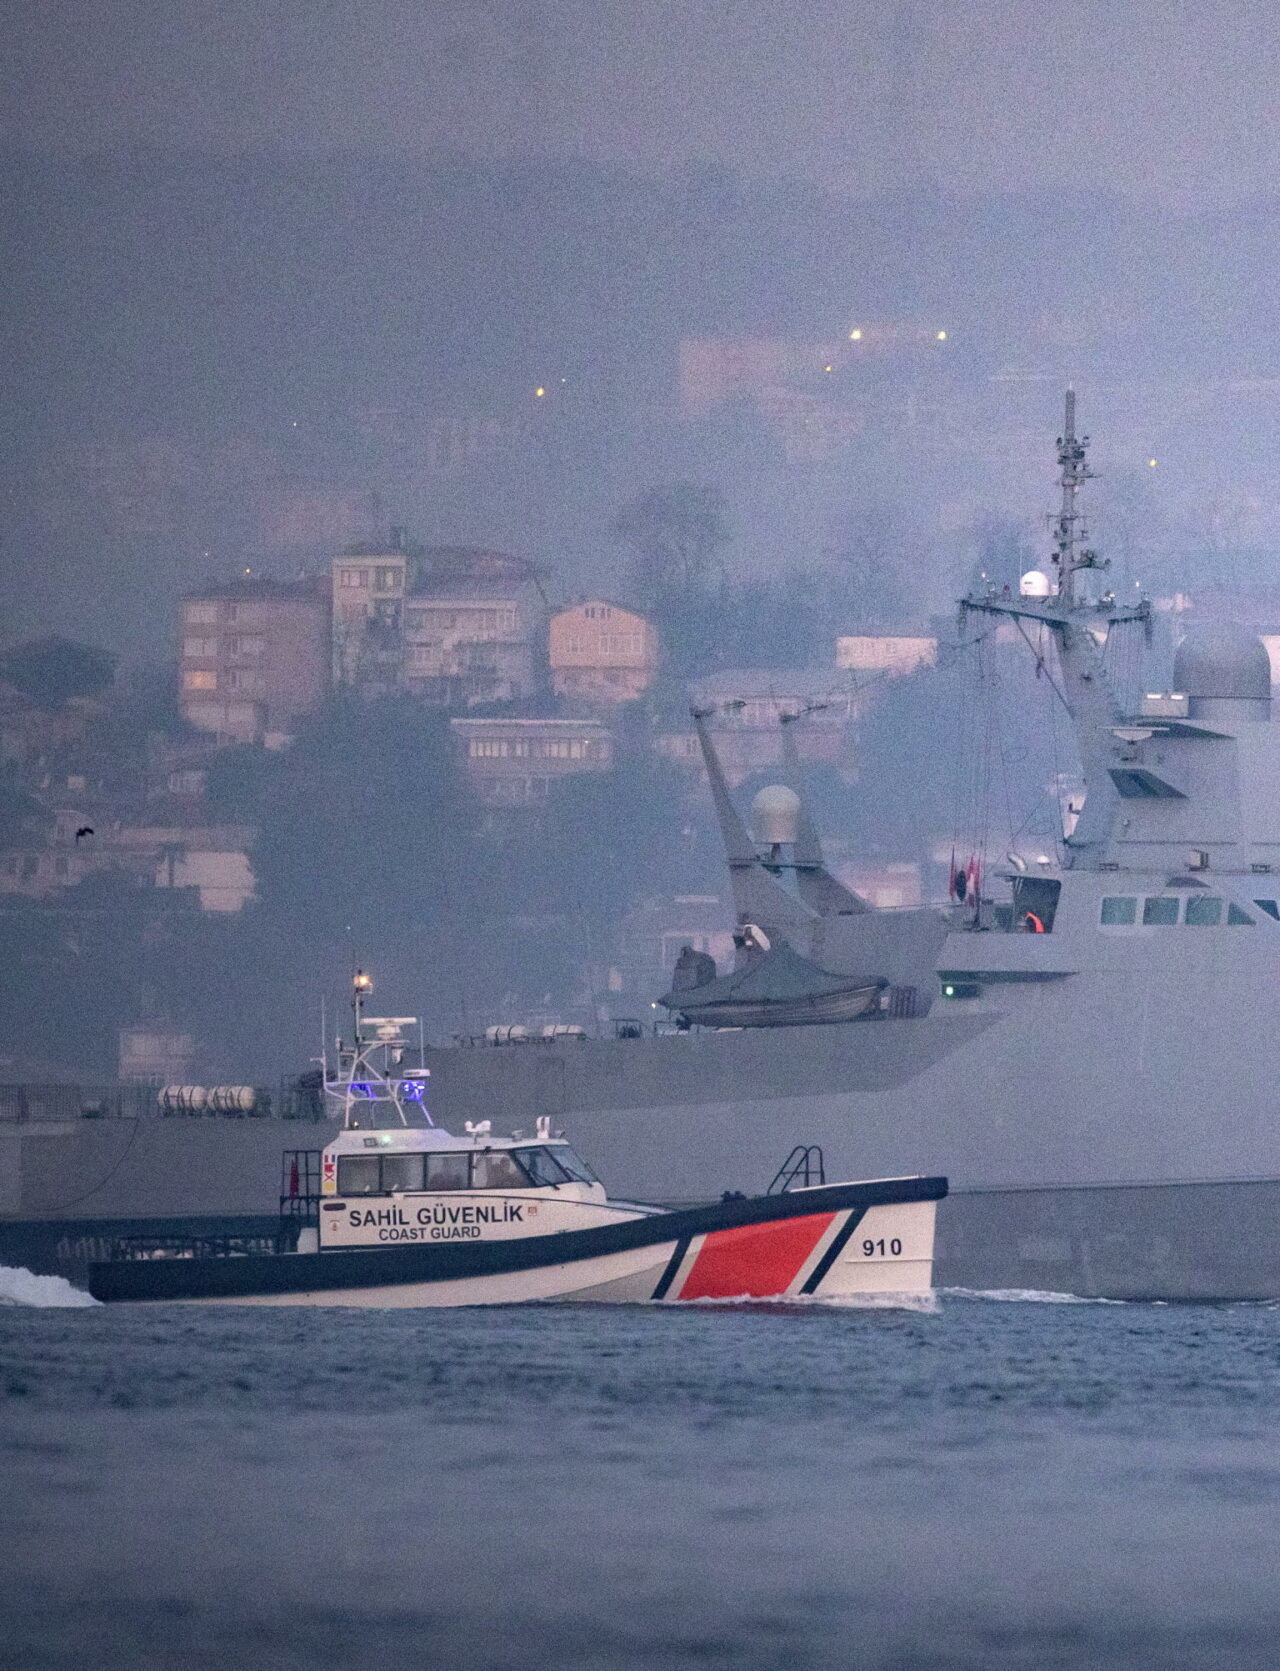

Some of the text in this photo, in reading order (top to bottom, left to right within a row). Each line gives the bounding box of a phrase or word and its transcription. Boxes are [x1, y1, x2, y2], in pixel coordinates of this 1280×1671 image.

[350, 1202, 523, 1227] SAHİL GÜVENLİK
[379, 1226, 481, 1241] COAST GUARD
[863, 1238, 902, 1256] 910
